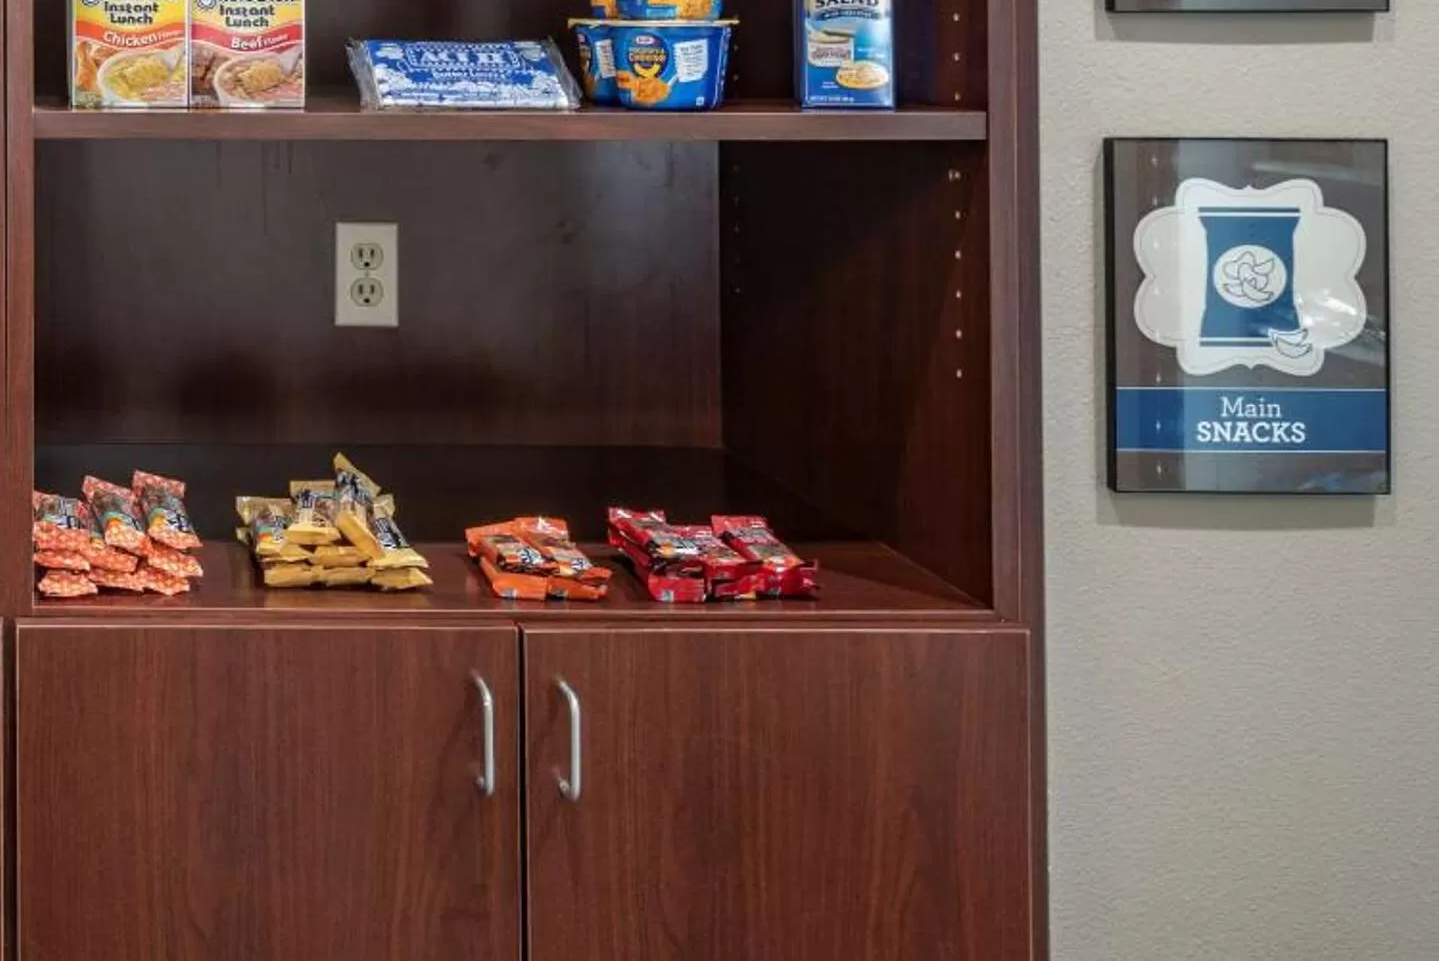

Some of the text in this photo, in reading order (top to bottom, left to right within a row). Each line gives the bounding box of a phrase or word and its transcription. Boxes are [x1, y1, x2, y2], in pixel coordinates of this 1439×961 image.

[104, 1, 159, 13] Instant
[220, 5, 276, 16] Instant
[110, 13, 153, 24] Lunch
[225, 16, 269, 27] Lunch
[103, 30, 157, 47] Chicken
[231, 35, 263, 50] Beef
[1220, 396, 1282, 418] Main
[1196, 421, 1306, 444] SNACKS
